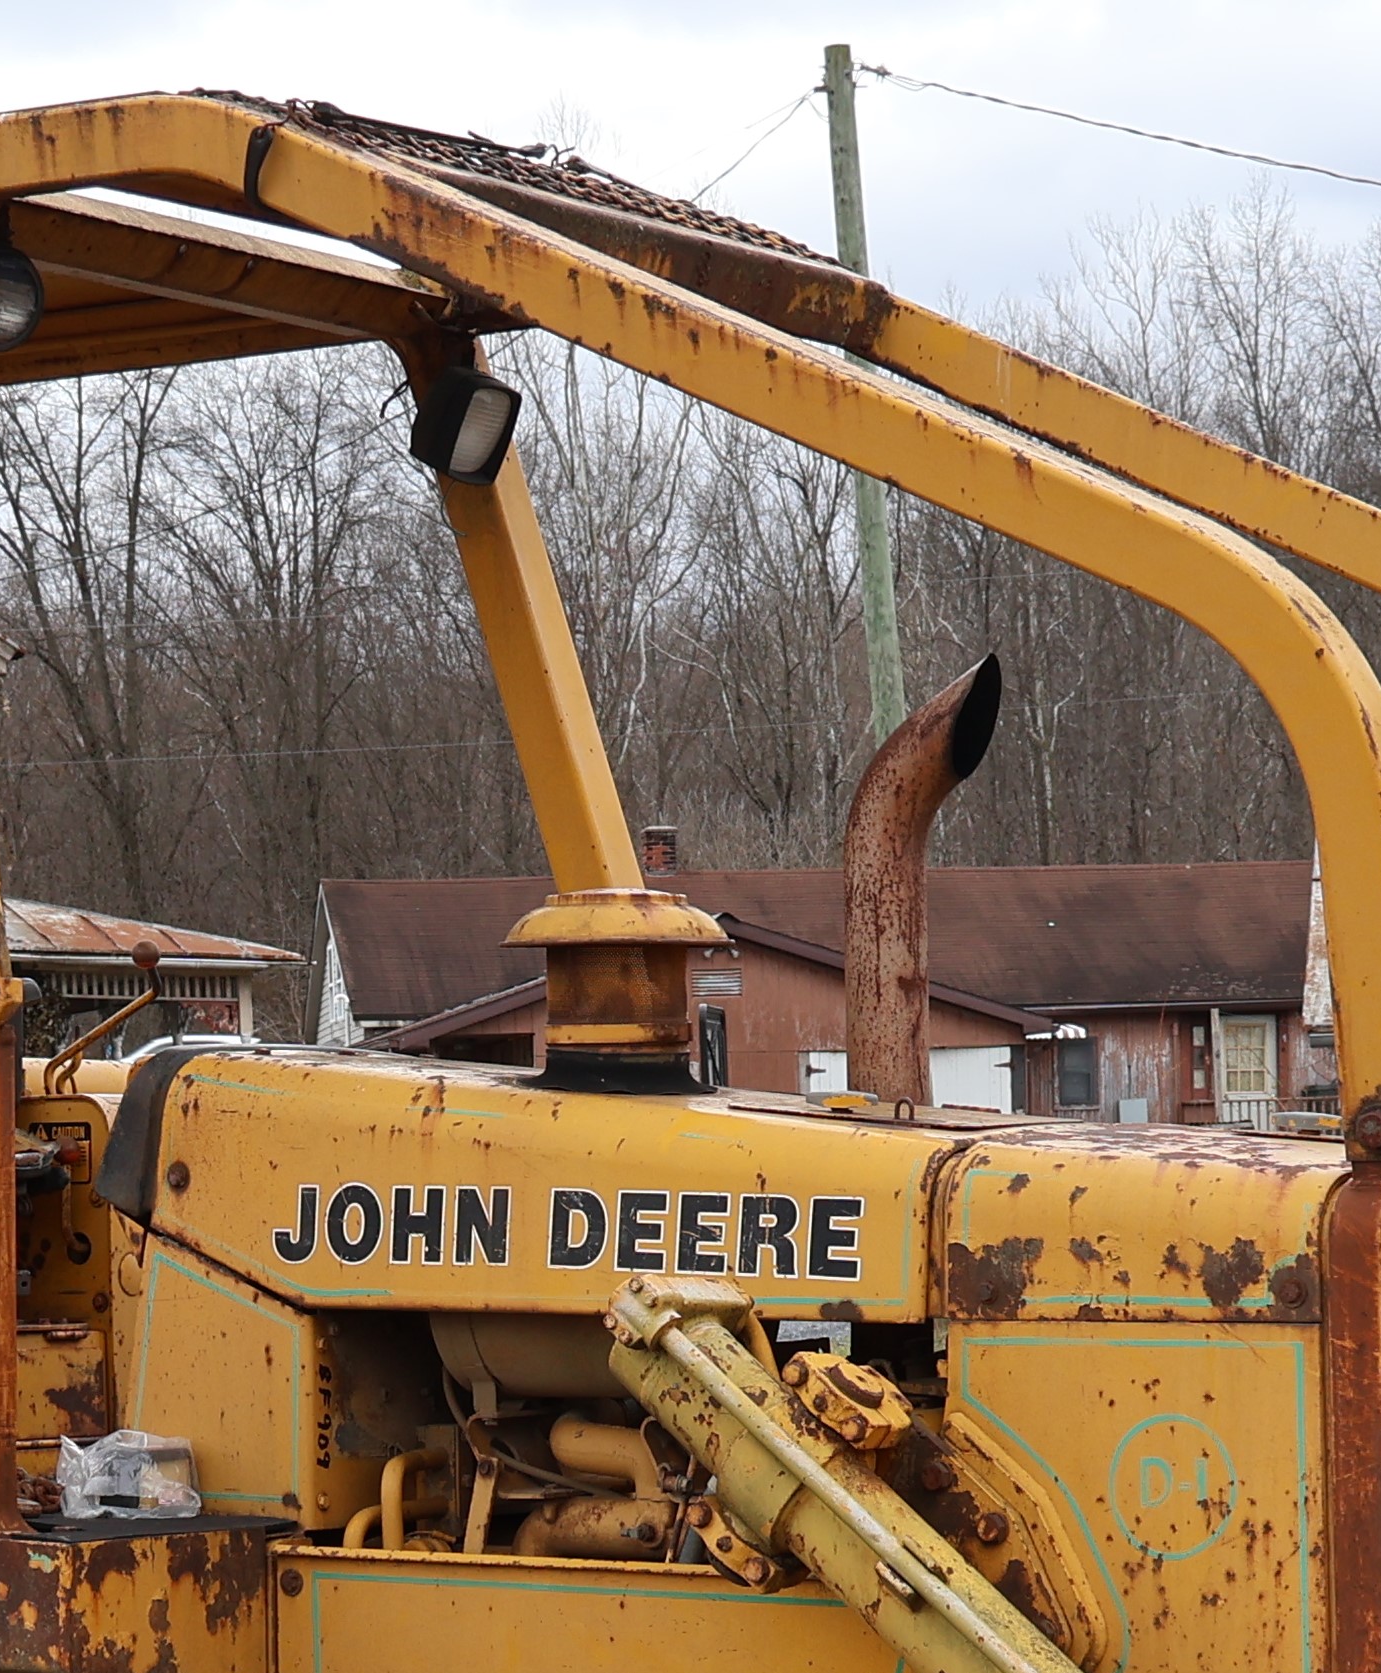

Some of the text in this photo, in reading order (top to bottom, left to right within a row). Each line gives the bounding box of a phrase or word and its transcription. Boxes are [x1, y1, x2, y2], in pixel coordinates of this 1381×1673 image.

[52, 1126, 85, 1139] CAUTION
[272, 1182, 865, 1282] JOHN DEERE
